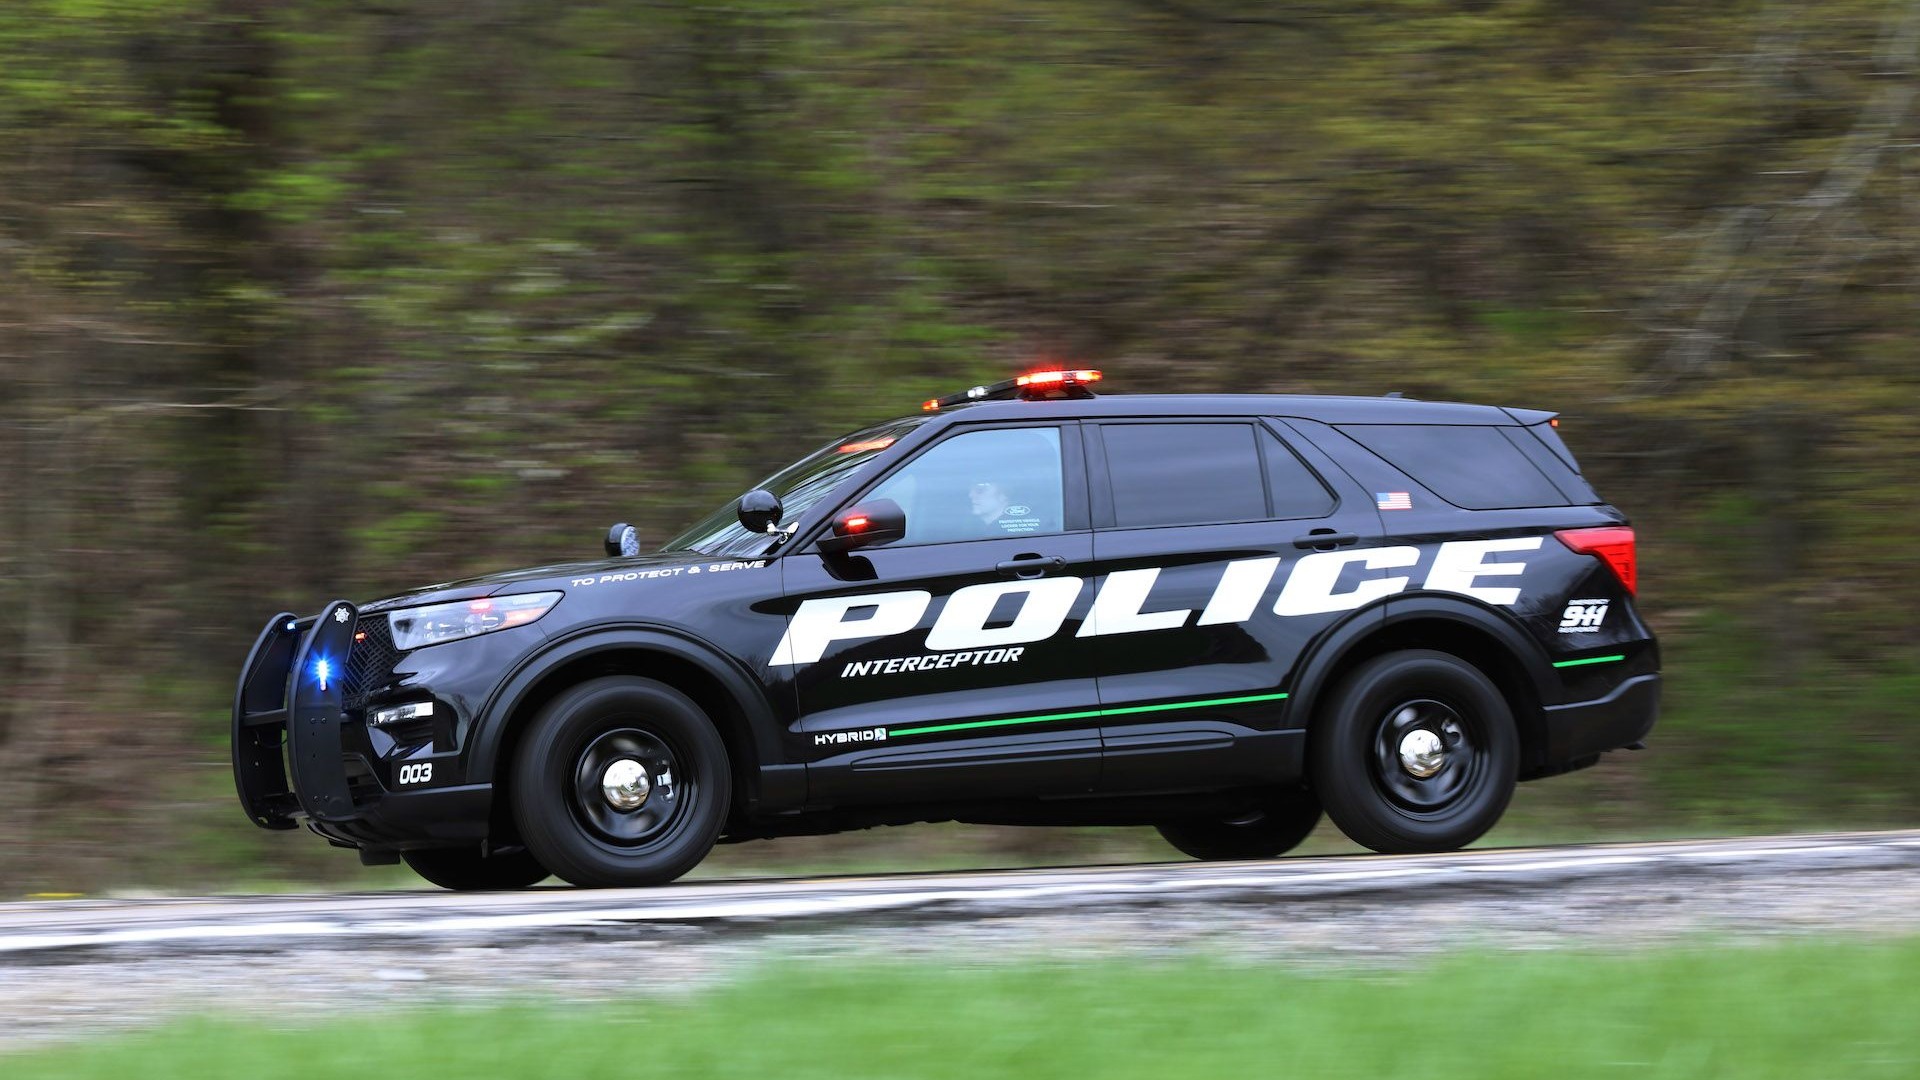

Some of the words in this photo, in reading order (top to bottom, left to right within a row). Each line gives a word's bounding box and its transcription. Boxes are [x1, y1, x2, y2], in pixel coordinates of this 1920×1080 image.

[571, 578, 595, 587] TO
[599, 568, 684, 584] PROTECT
[687, 566, 701, 574] &
[708, 560, 766, 573] SERVE
[768, 537, 1543, 666] POLICE
[1560, 605, 1608, 627] 911
[840, 647, 1025, 678] INTERCEPTOR
[814, 729, 875, 745] HYBRID
[399, 762, 432, 784] 003
